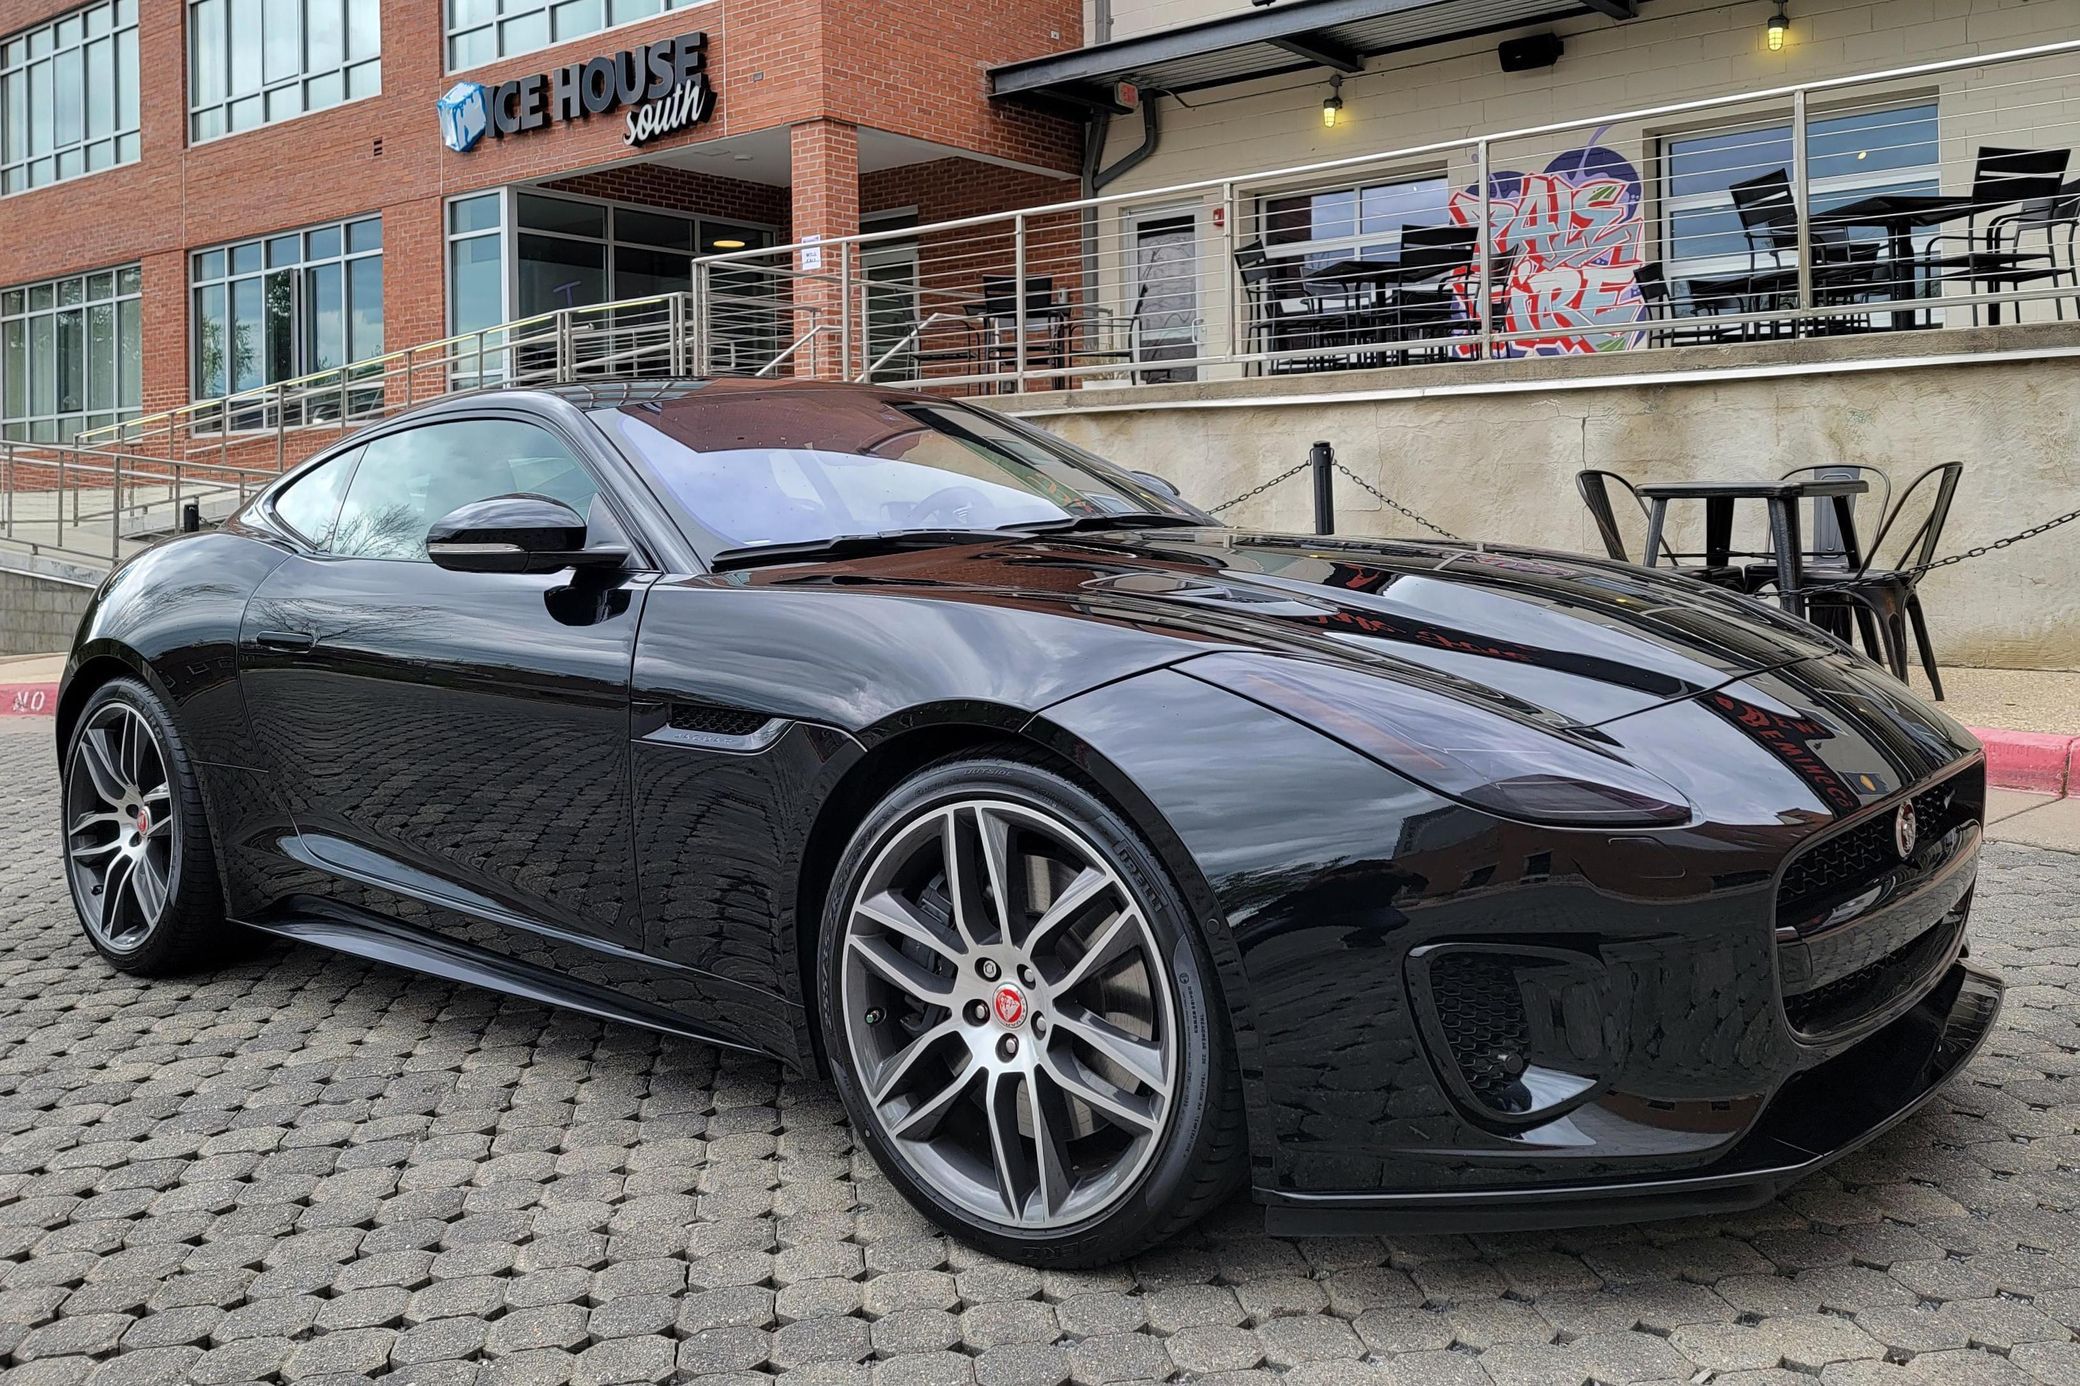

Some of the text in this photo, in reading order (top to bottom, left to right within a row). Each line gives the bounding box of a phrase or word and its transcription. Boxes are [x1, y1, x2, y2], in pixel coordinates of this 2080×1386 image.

[484, 32, 706, 138] ICE HOUSE
[623, 79, 706, 146] south
[13, 691, 45, 713] NO
[1111, 838, 1169, 912] PIRELLI
